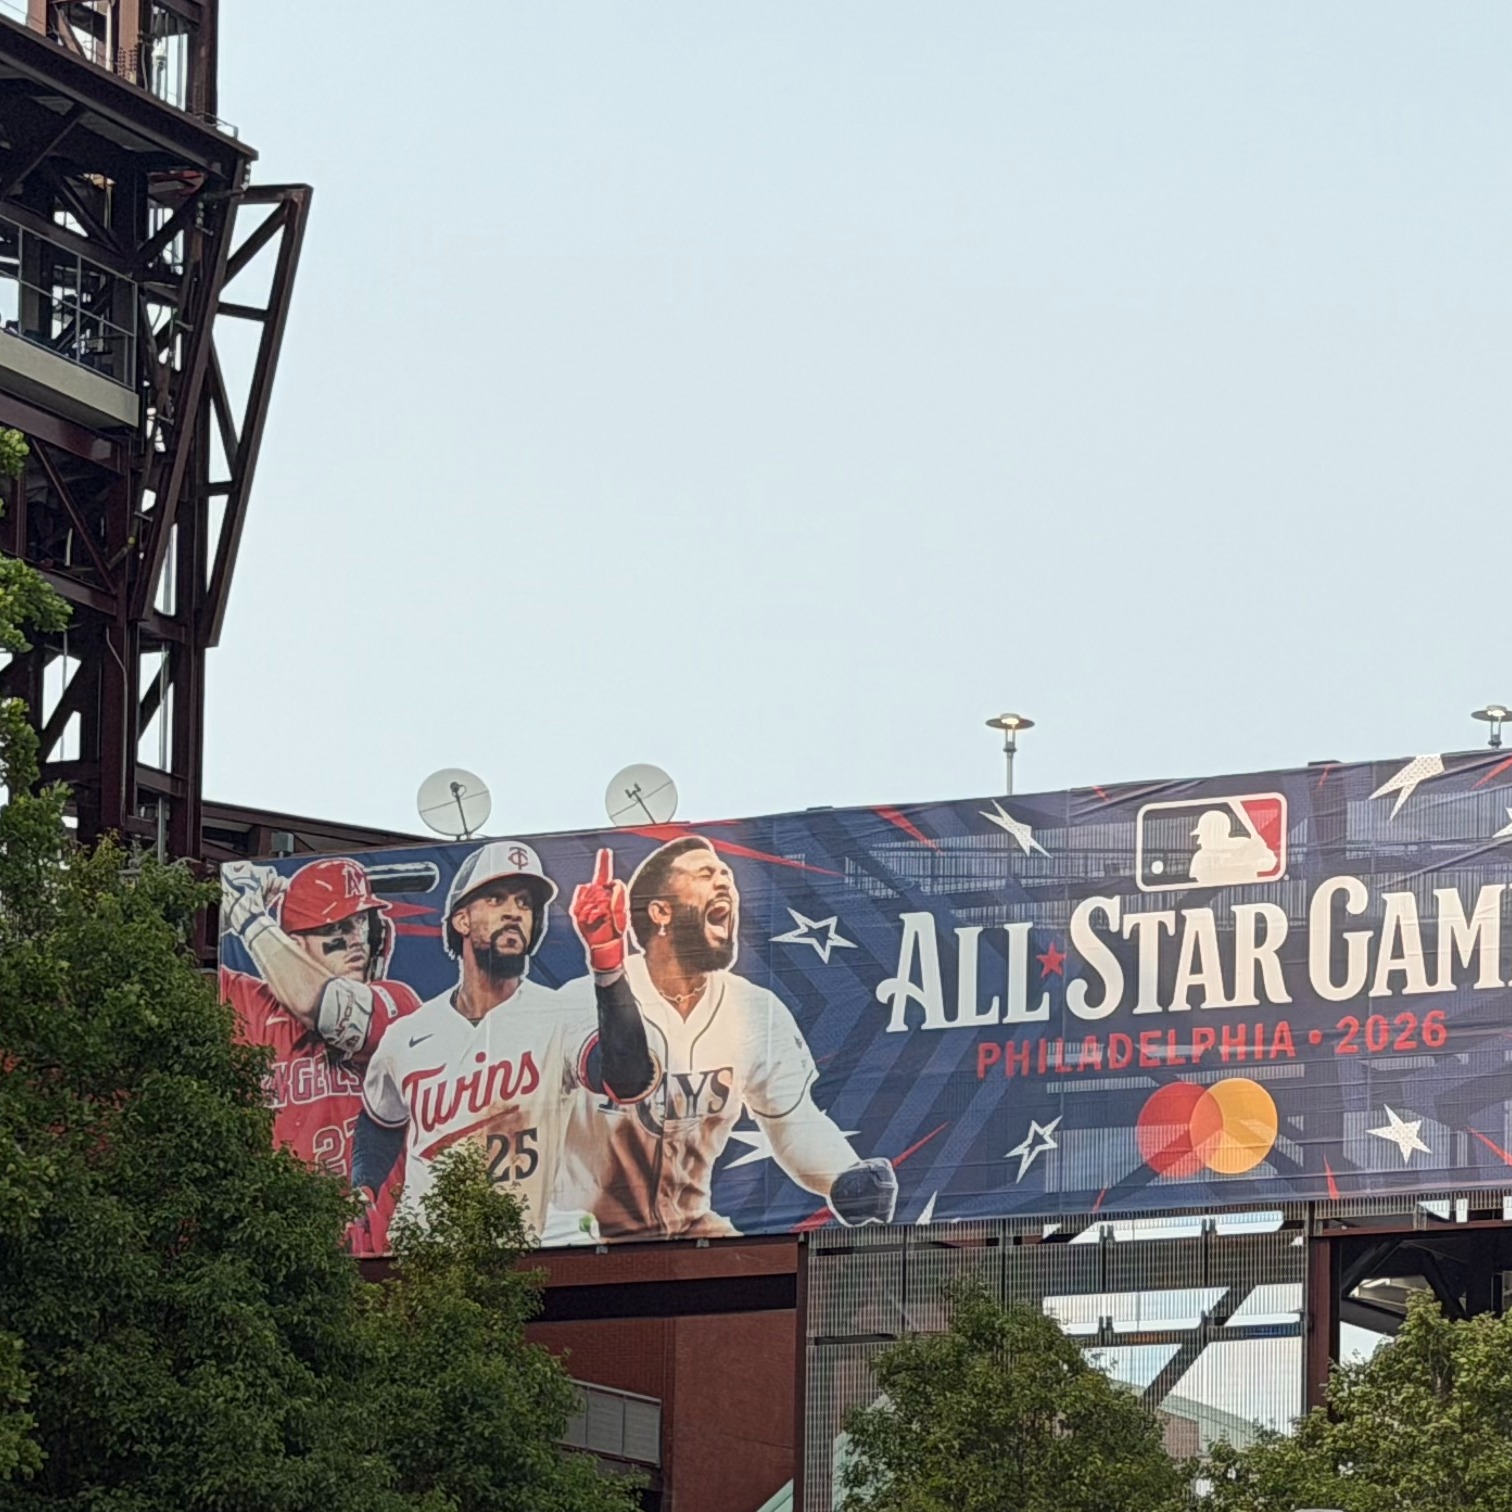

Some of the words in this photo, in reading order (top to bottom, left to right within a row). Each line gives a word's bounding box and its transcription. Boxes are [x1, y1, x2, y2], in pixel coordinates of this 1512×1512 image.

[876, 911, 1050, 1033] ALL
[1066, 896, 1292, 1020] STAR
[976, 1020, 1297, 1080] PHILADELPHIA
[1335, 1008, 1448, 1054] 2026
[402, 1050, 541, 1149] Twins
[486, 1127, 540, 1183] 25
